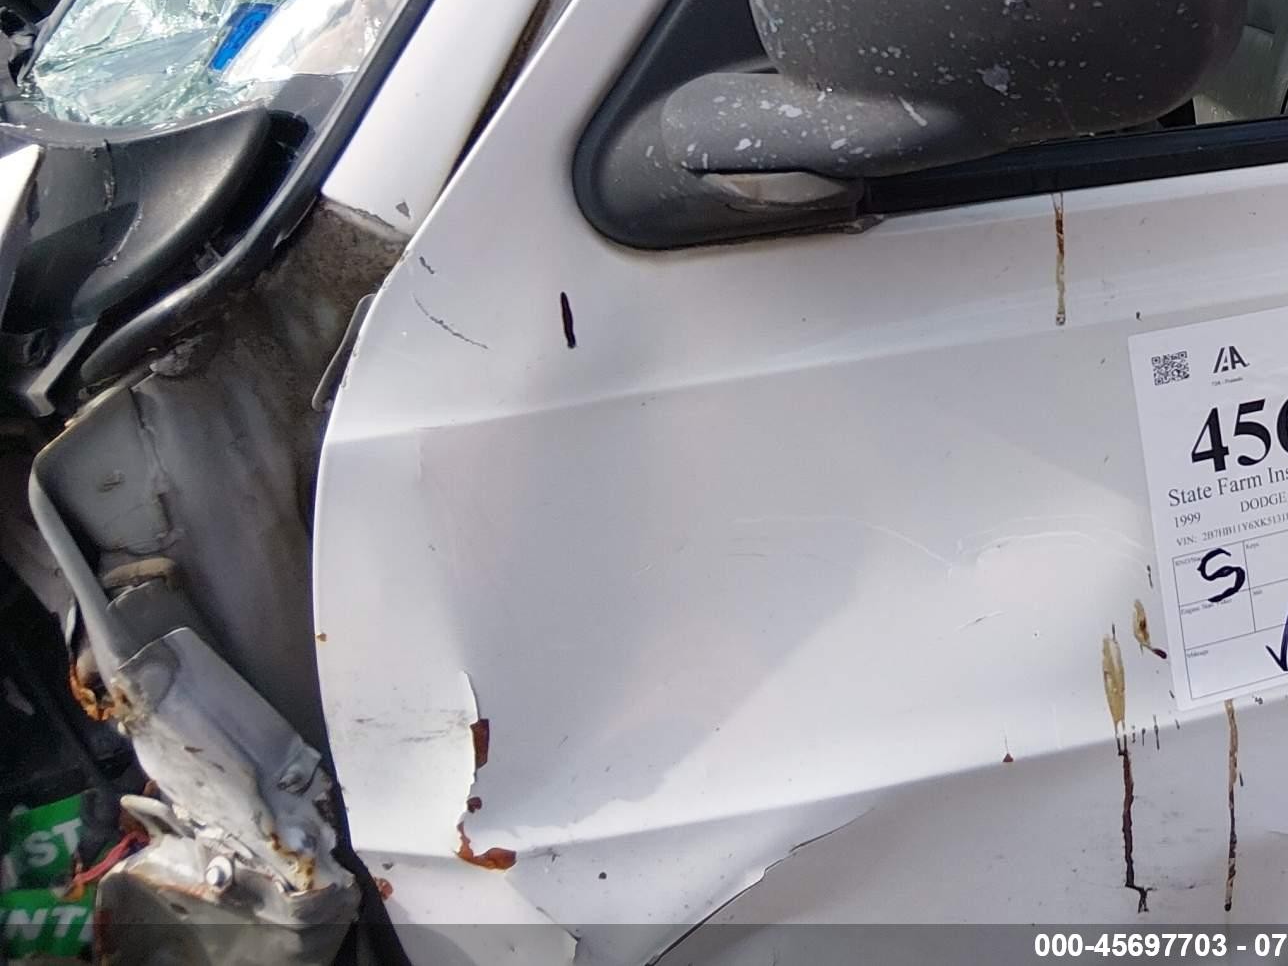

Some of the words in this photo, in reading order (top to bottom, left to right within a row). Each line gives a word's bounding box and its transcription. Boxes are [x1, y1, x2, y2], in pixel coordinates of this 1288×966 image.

[1168, 485, 1212, 507] State
[1217, 475, 1262, 496] Farm
[1174, 512, 1201, 528] 1999
[1240, 491, 1287, 513] DODGE
